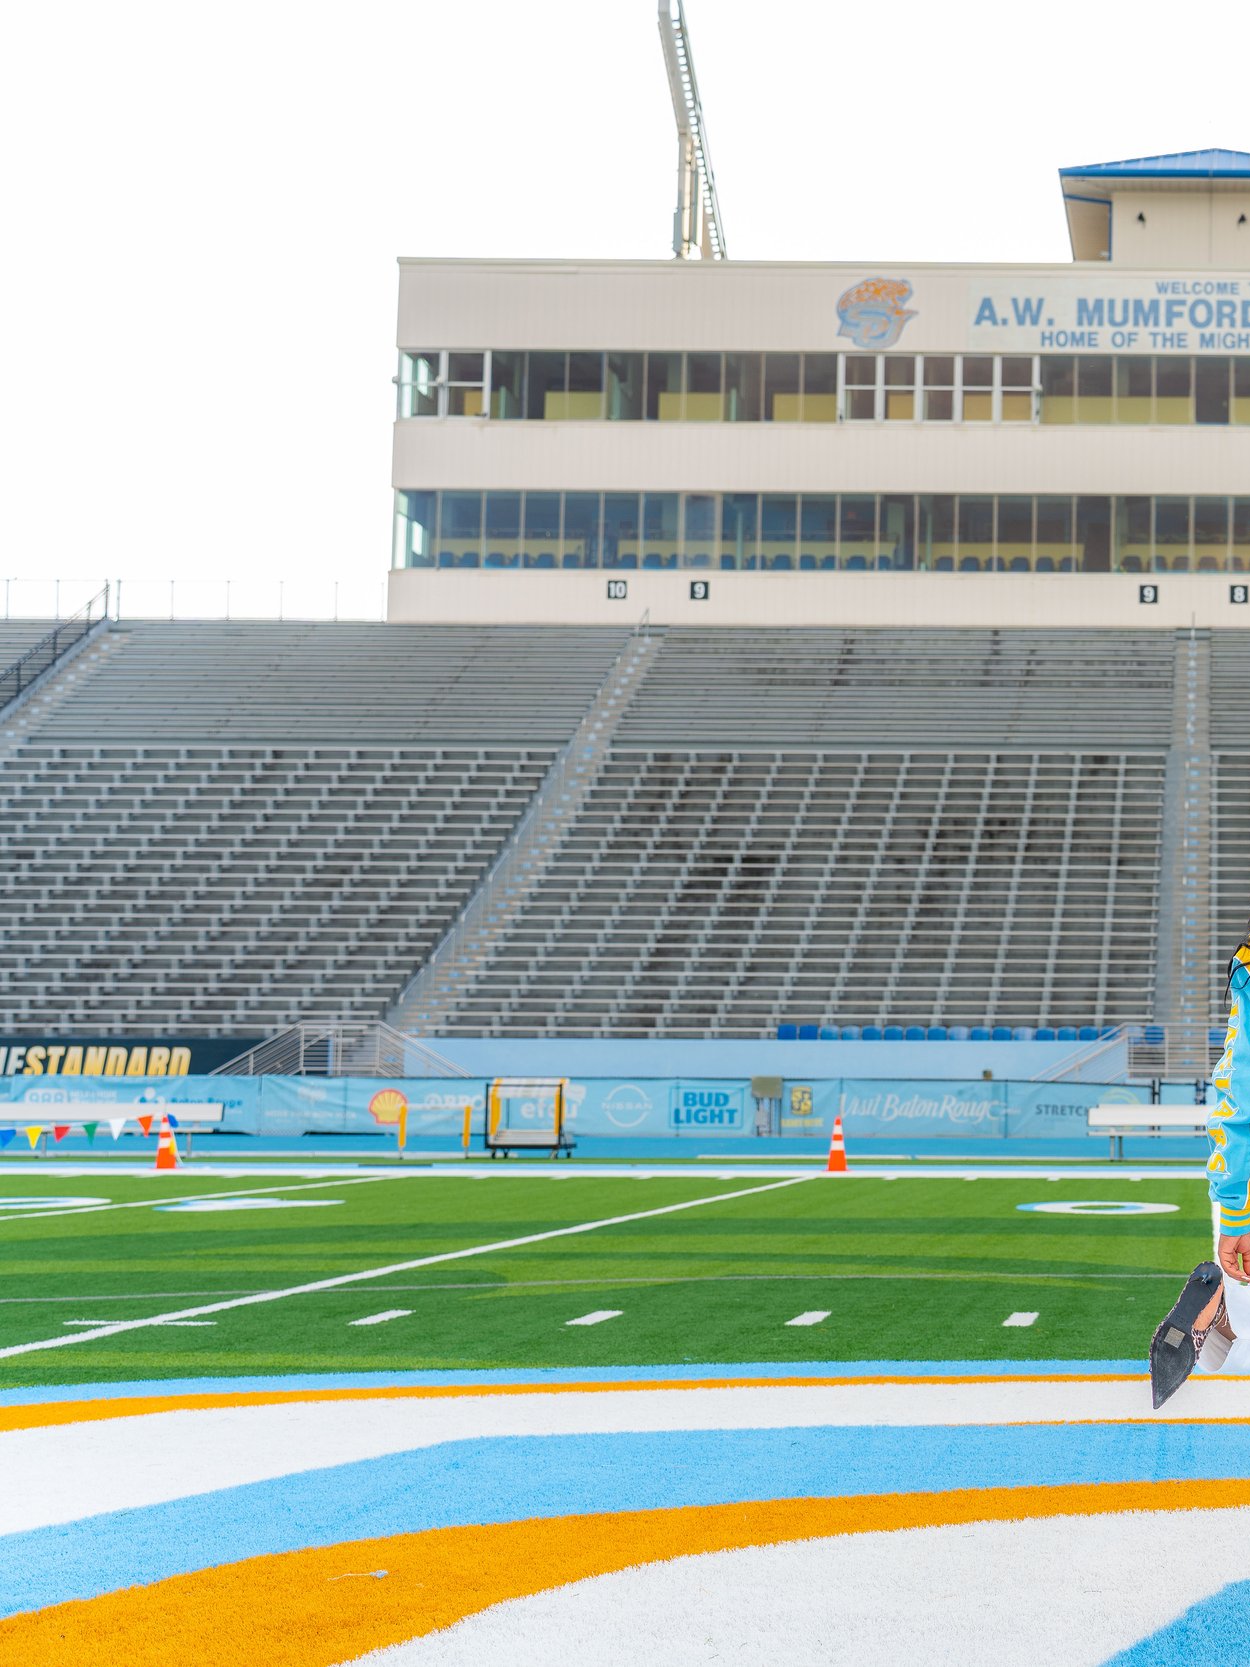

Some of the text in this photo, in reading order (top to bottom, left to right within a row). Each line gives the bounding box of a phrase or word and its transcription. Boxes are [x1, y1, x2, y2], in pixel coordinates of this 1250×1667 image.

[1156, 281, 1240, 295] WELCOME
[973, 297, 1055, 326] A.W.
[1040, 330, 1099, 347] HOME
[1111, 331, 1138, 348] OF
[1150, 332, 1188, 348] THE
[609, 581, 627, 598] 10
[693, 582, 706, 599] 9
[1143, 586, 1155, 603] 9
[1233, 586, 1246, 603] 8
[683, 1091, 730, 1107] BUD
[880, 1093, 940, 1122] Baton
[673, 1108, 738, 1125] LIGHT
